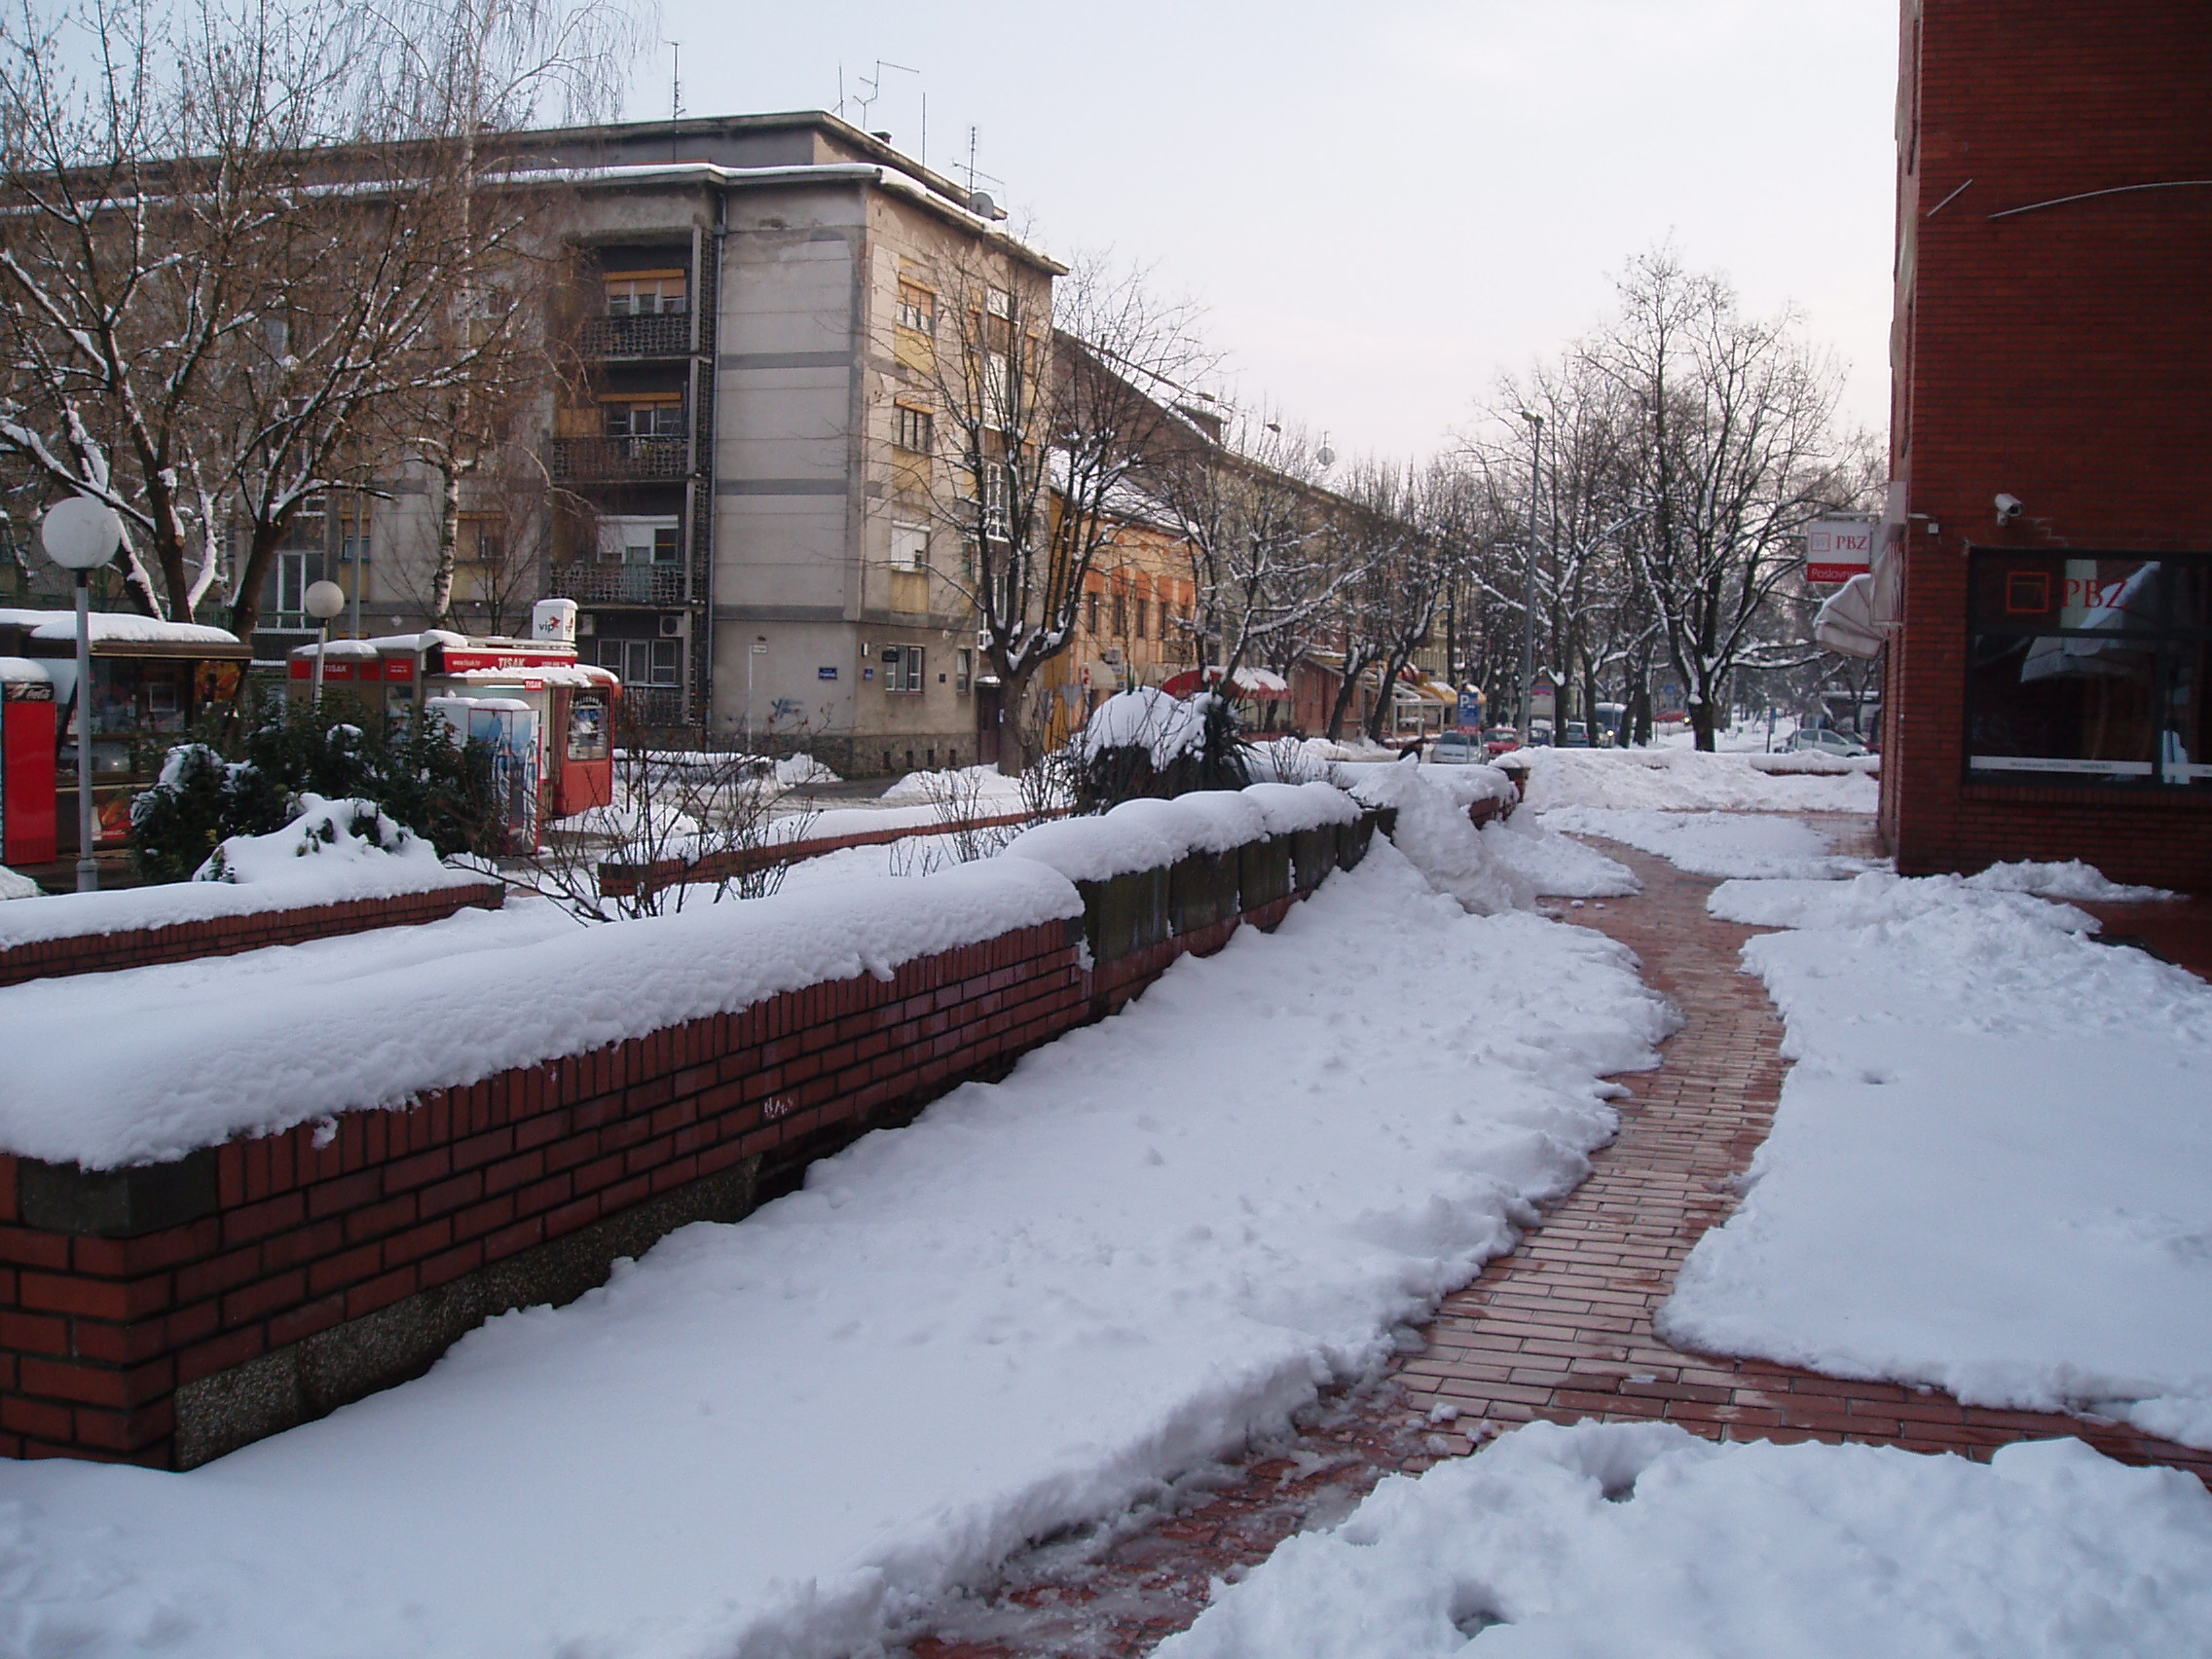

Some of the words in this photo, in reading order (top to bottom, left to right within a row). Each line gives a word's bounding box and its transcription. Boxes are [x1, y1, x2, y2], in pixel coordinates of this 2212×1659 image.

[1837, 535, 1867, 550] PBZ
[2061, 578, 2129, 609] PBZ
[538, 621, 555, 634] vip
[324, 665, 347, 674] TISAK
[498, 657, 526, 669] TISAK
[526, 681, 542, 689] TISAK
[1460, 694, 1469, 709] P
